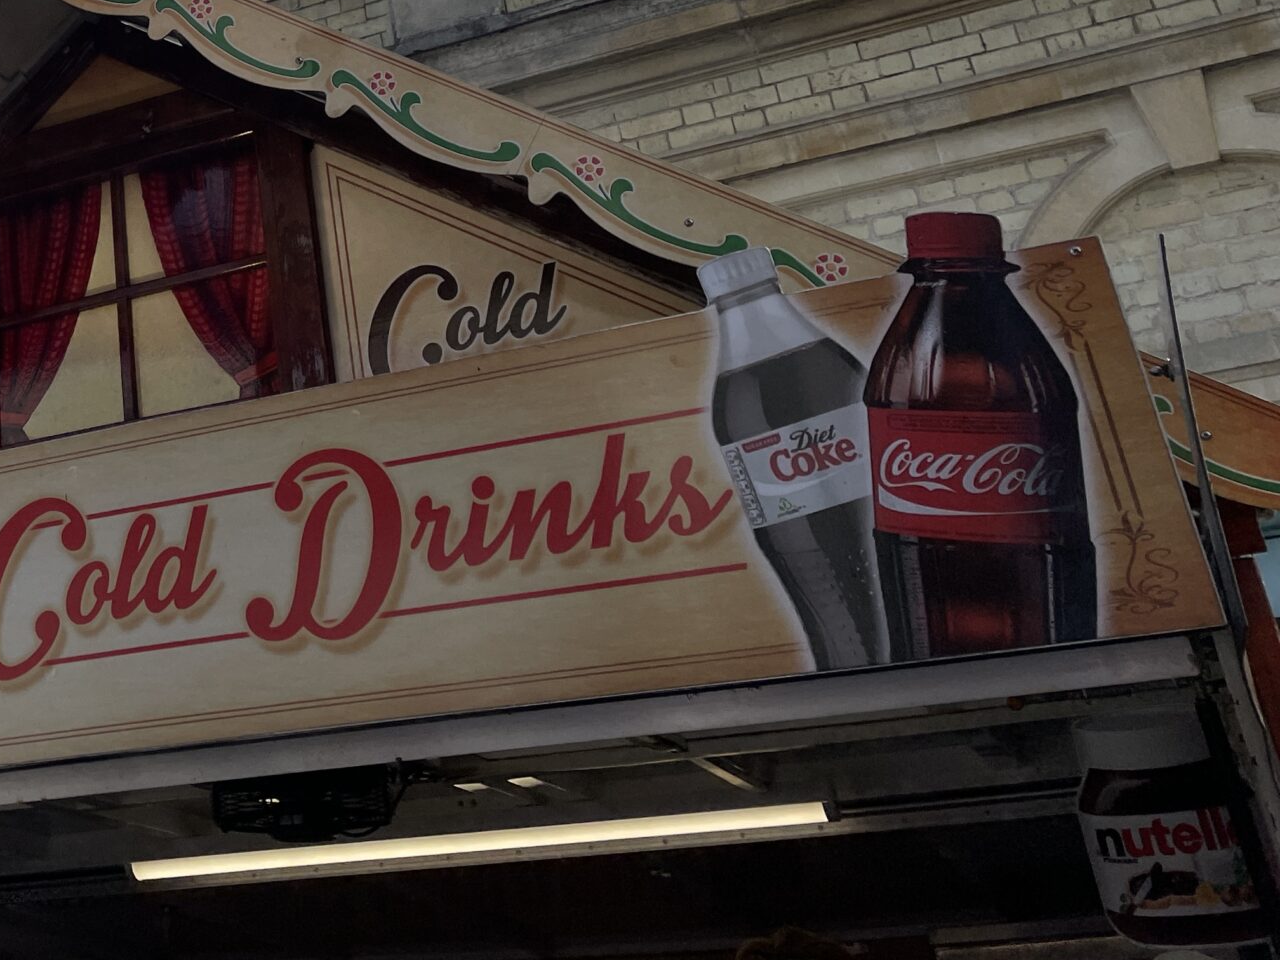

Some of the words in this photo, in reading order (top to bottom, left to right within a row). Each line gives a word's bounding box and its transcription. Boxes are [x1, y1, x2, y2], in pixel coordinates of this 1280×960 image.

[368, 261, 567, 378] Cold
[770, 438, 858, 482] Coke
[790, 424, 836, 453] Diet
[879, 438, 1065, 496] Coca-Cola
[246, 433, 733, 640] Drinks
